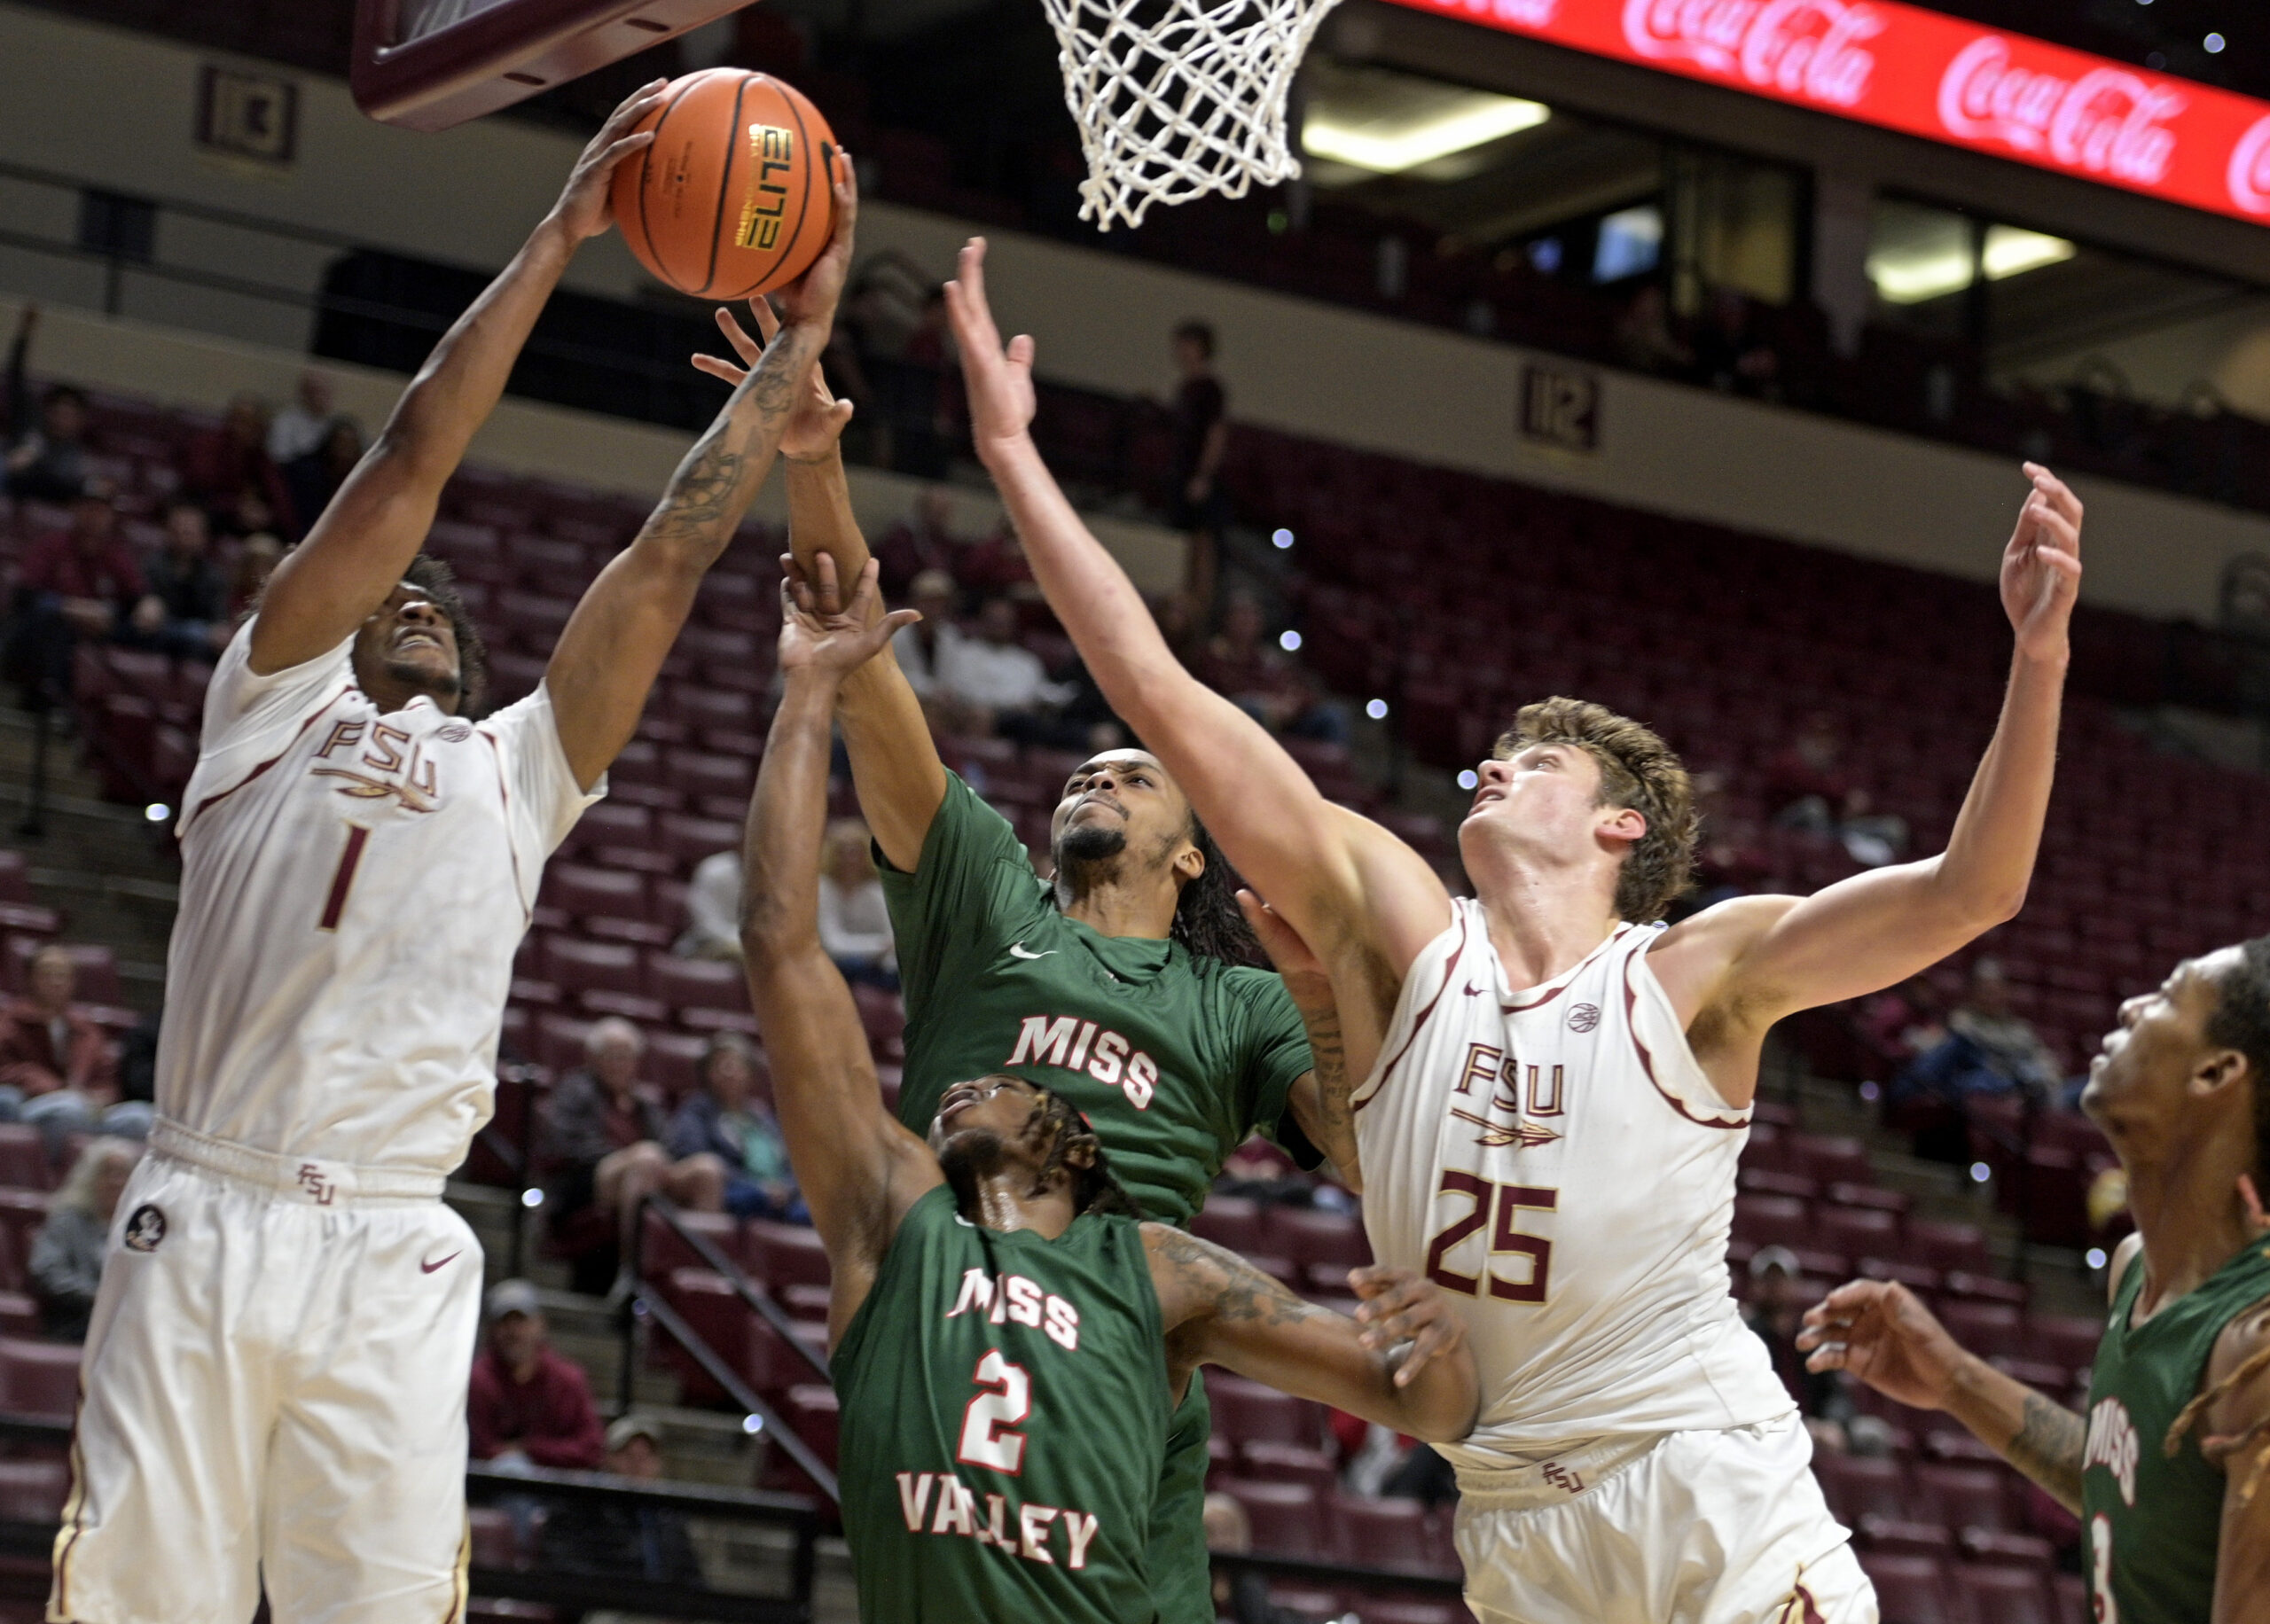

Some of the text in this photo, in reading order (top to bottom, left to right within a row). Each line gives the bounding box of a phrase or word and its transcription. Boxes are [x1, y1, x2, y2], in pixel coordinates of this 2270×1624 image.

[746, 124, 794, 251] ELITE
[313, 719, 438, 799] FSU
[316, 819, 372, 933] 1
[1004, 1013, 1160, 1112] MISS
[1452, 1042, 1565, 1119] FSU
[297, 1163, 336, 1206] FSU
[1426, 1168, 1559, 1306] 25
[945, 1267, 1080, 1352] MISS
[956, 1347, 1031, 1477] 2
[2082, 1396, 2141, 1507] MISS
[1542, 1462, 1585, 1494] FSU
